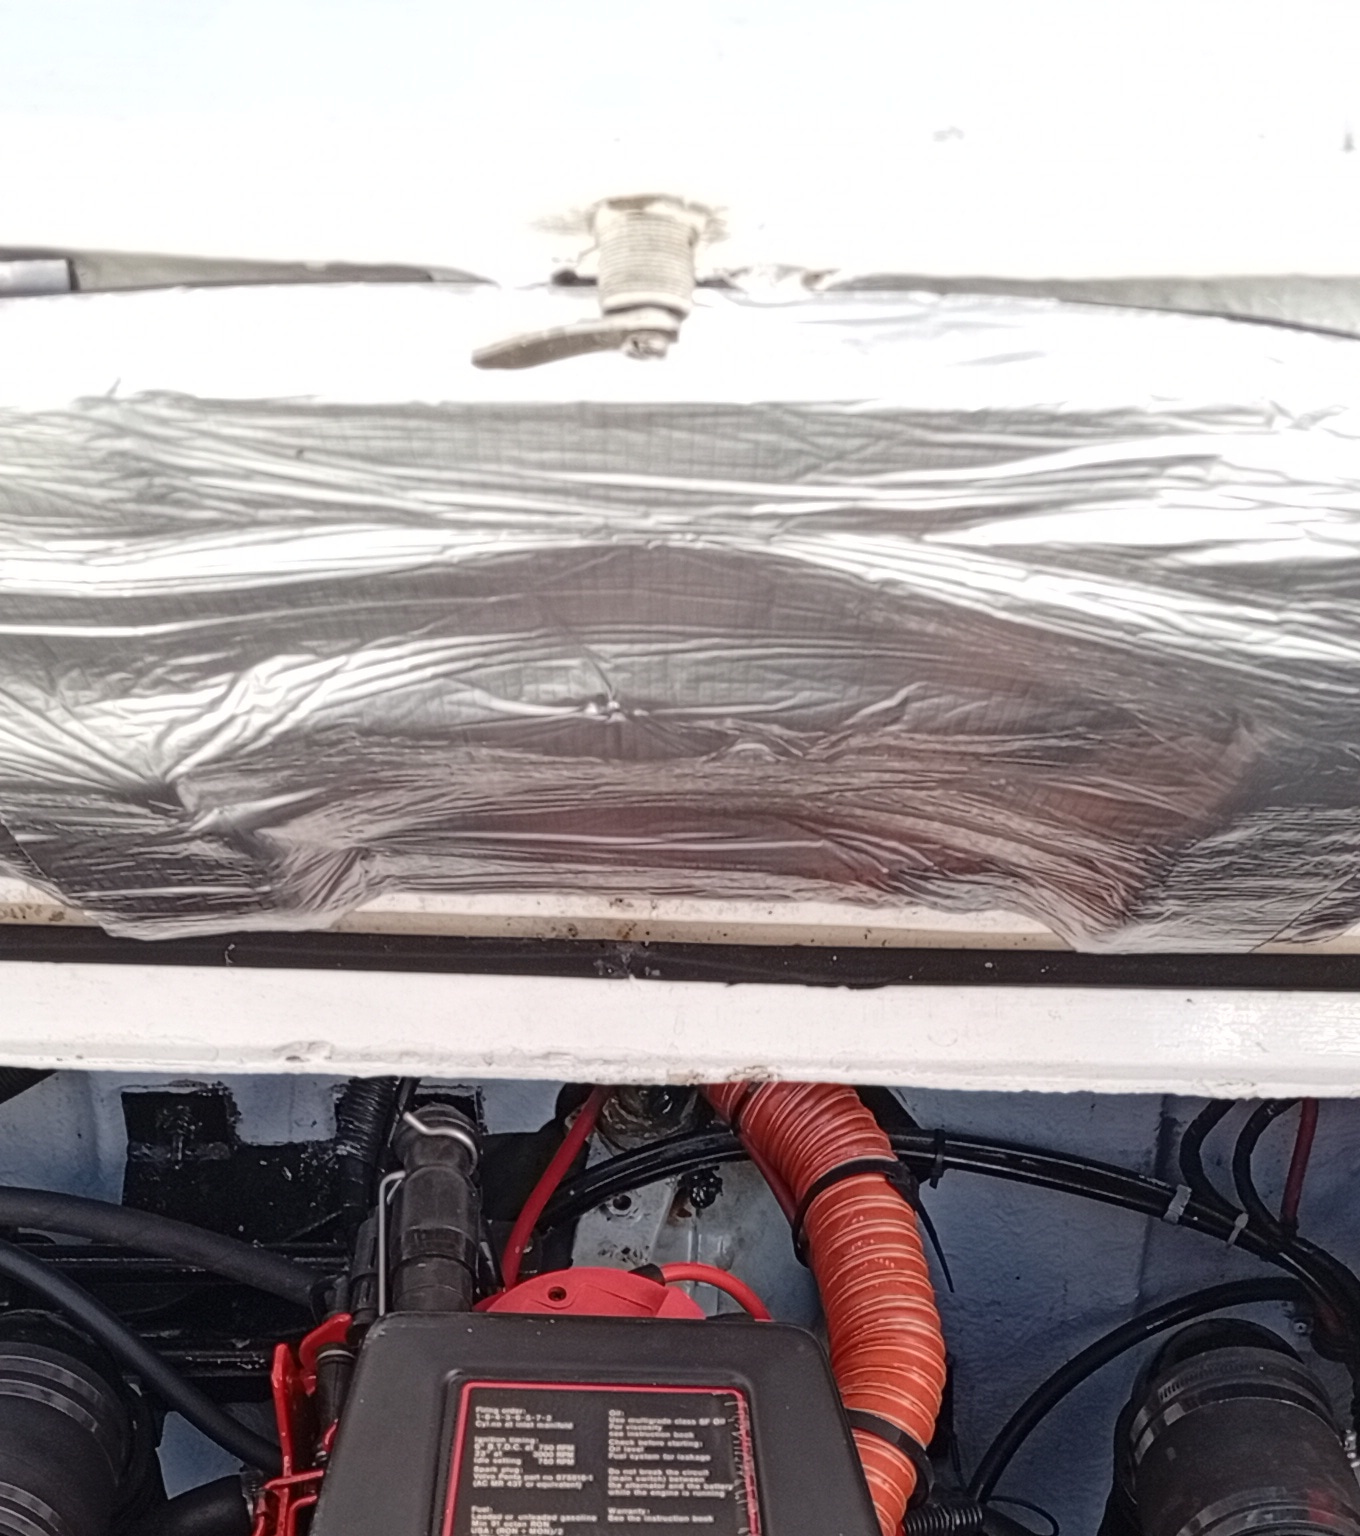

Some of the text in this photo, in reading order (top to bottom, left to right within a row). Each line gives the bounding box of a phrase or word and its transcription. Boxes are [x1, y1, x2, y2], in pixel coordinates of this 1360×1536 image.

[628, 1417, 671, 1425] multigrade
[629, 1453, 660, 1461] system
[677, 1454, 711, 1462] leakage
